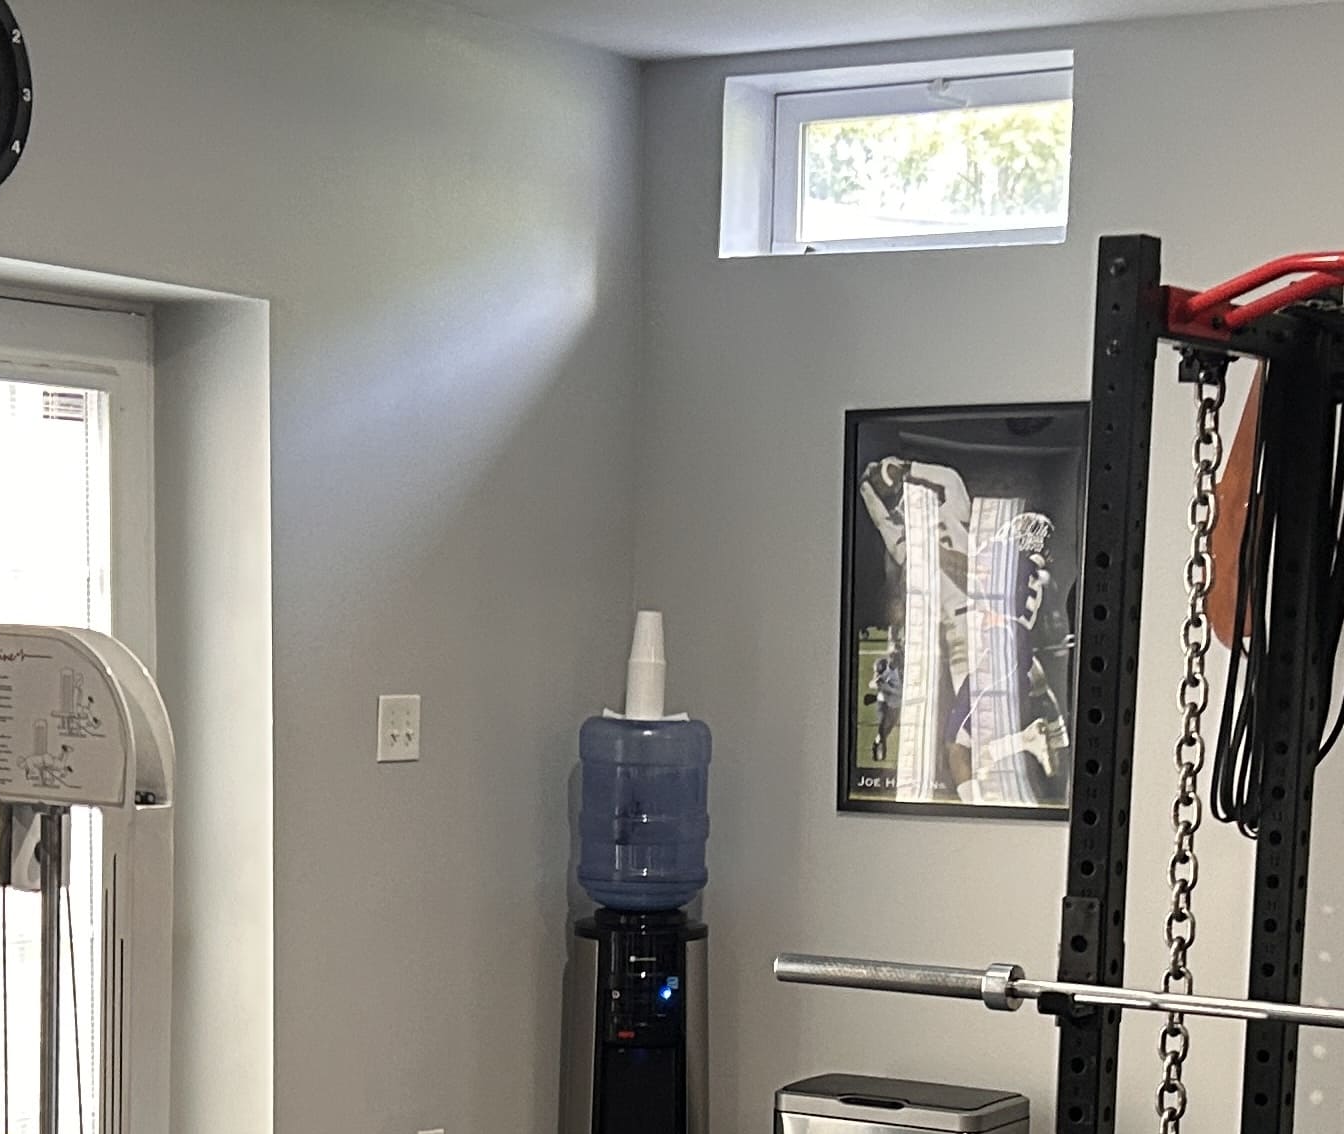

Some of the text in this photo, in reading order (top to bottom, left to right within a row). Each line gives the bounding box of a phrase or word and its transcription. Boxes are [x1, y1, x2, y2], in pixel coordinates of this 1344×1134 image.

[12, 29, 22, 44] 2
[23, 88, 31, 102] 3
[11, 140, 21, 154] 4
[857, 775, 881, 787] JOE
